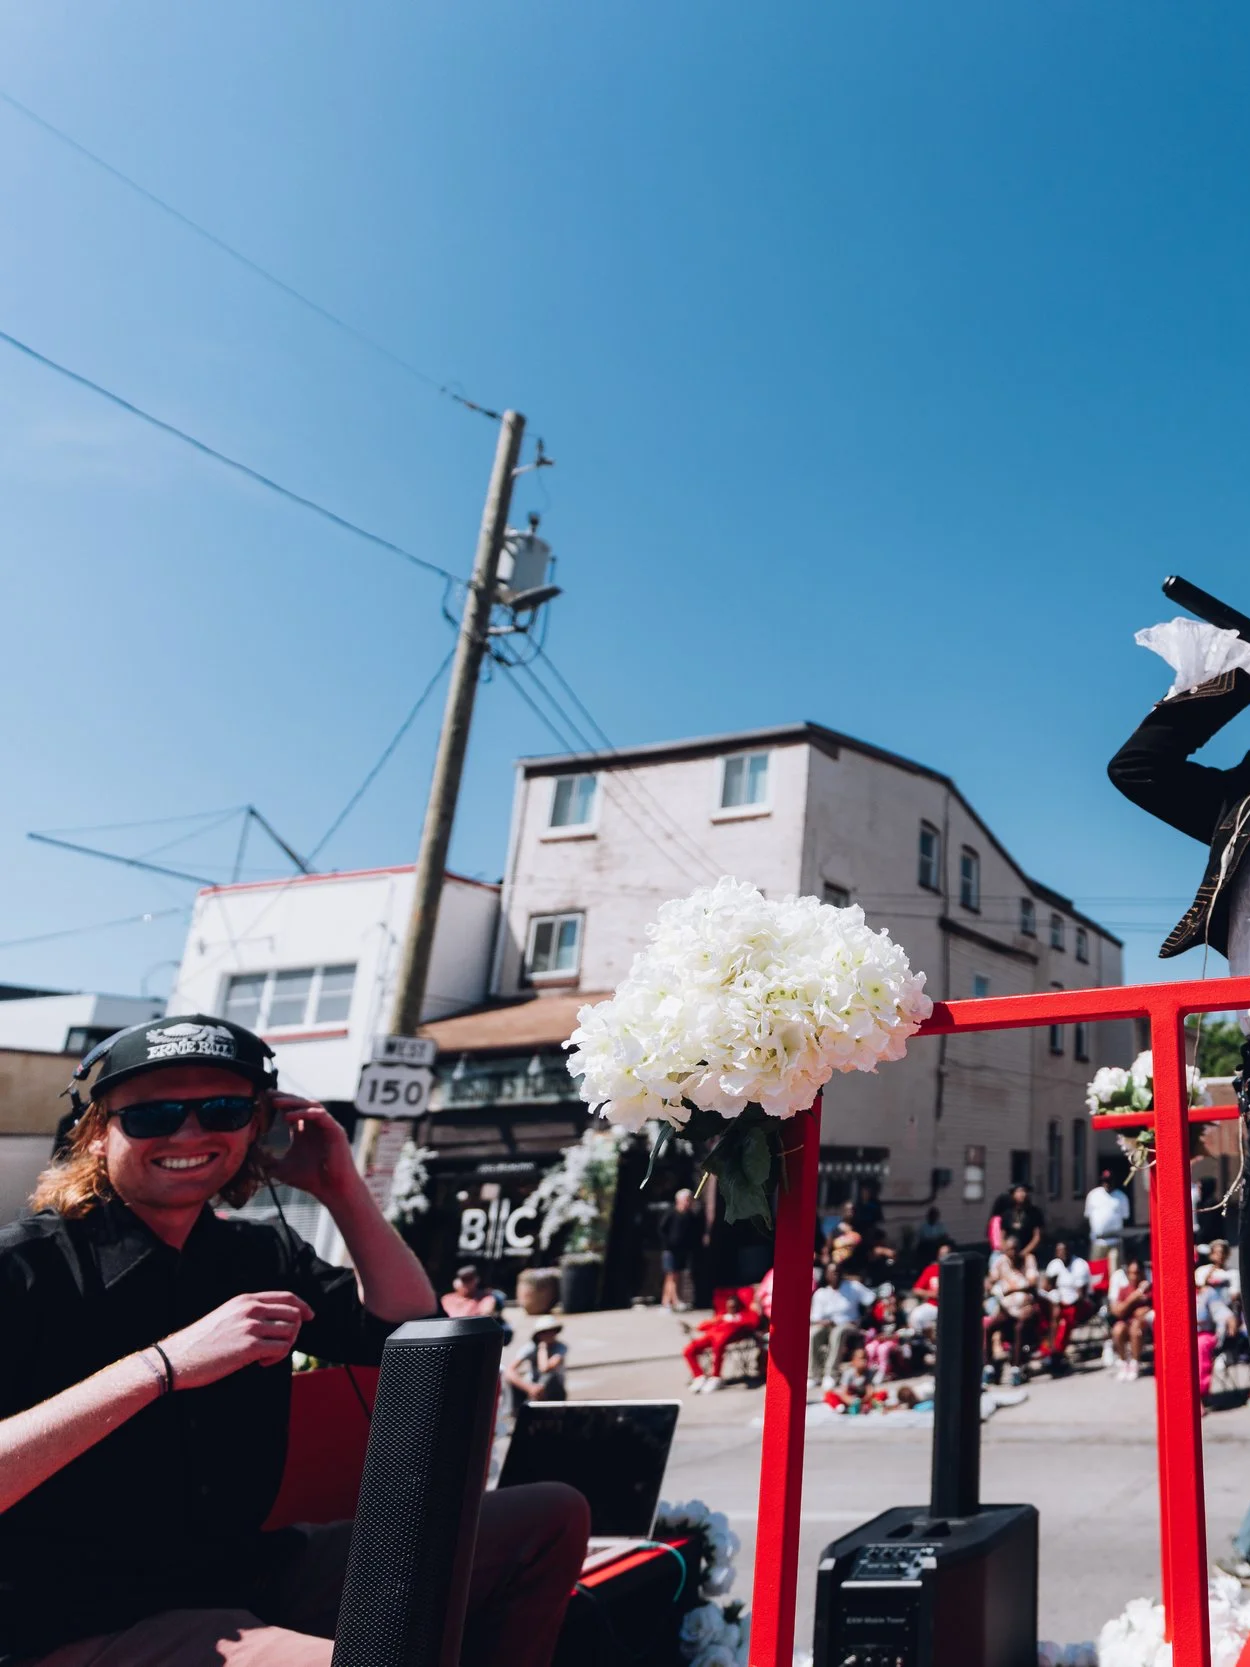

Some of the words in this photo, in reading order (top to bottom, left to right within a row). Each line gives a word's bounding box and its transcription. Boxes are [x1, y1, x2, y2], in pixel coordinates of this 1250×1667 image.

[147, 1040, 197, 1060] ERNIE
[384, 1041, 427, 1058] WEST
[367, 1079, 423, 1106] 150
